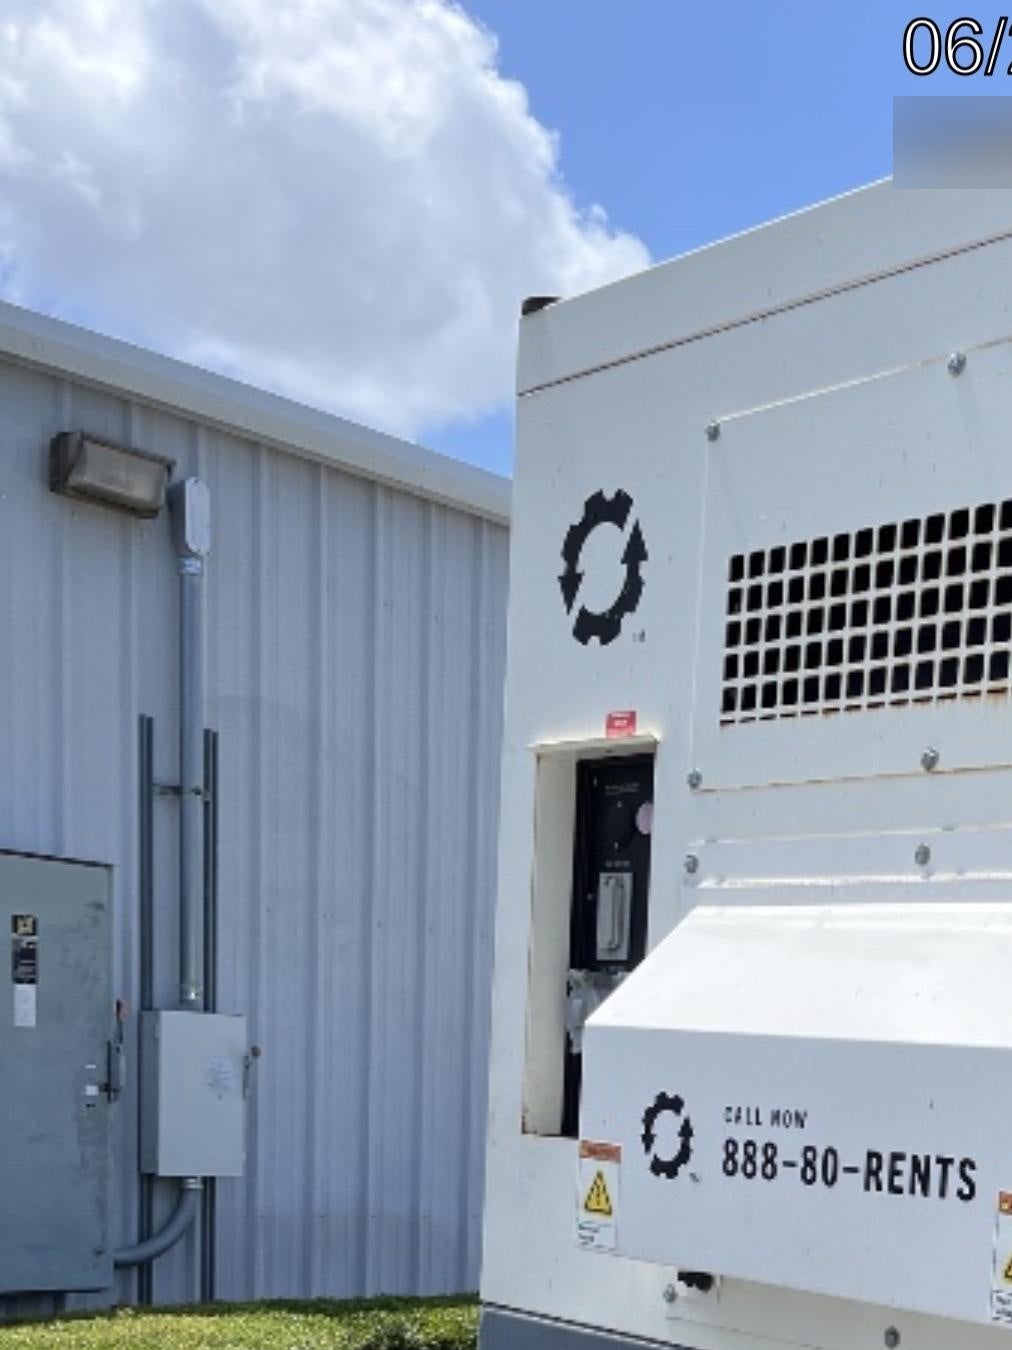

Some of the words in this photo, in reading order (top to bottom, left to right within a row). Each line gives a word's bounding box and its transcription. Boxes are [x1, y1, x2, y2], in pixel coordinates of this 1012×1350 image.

[723, 1106, 763, 1126] CALL
[770, 1109, 808, 1129] NOW
[722, 1137, 977, 1202] 888-80-RENTS
